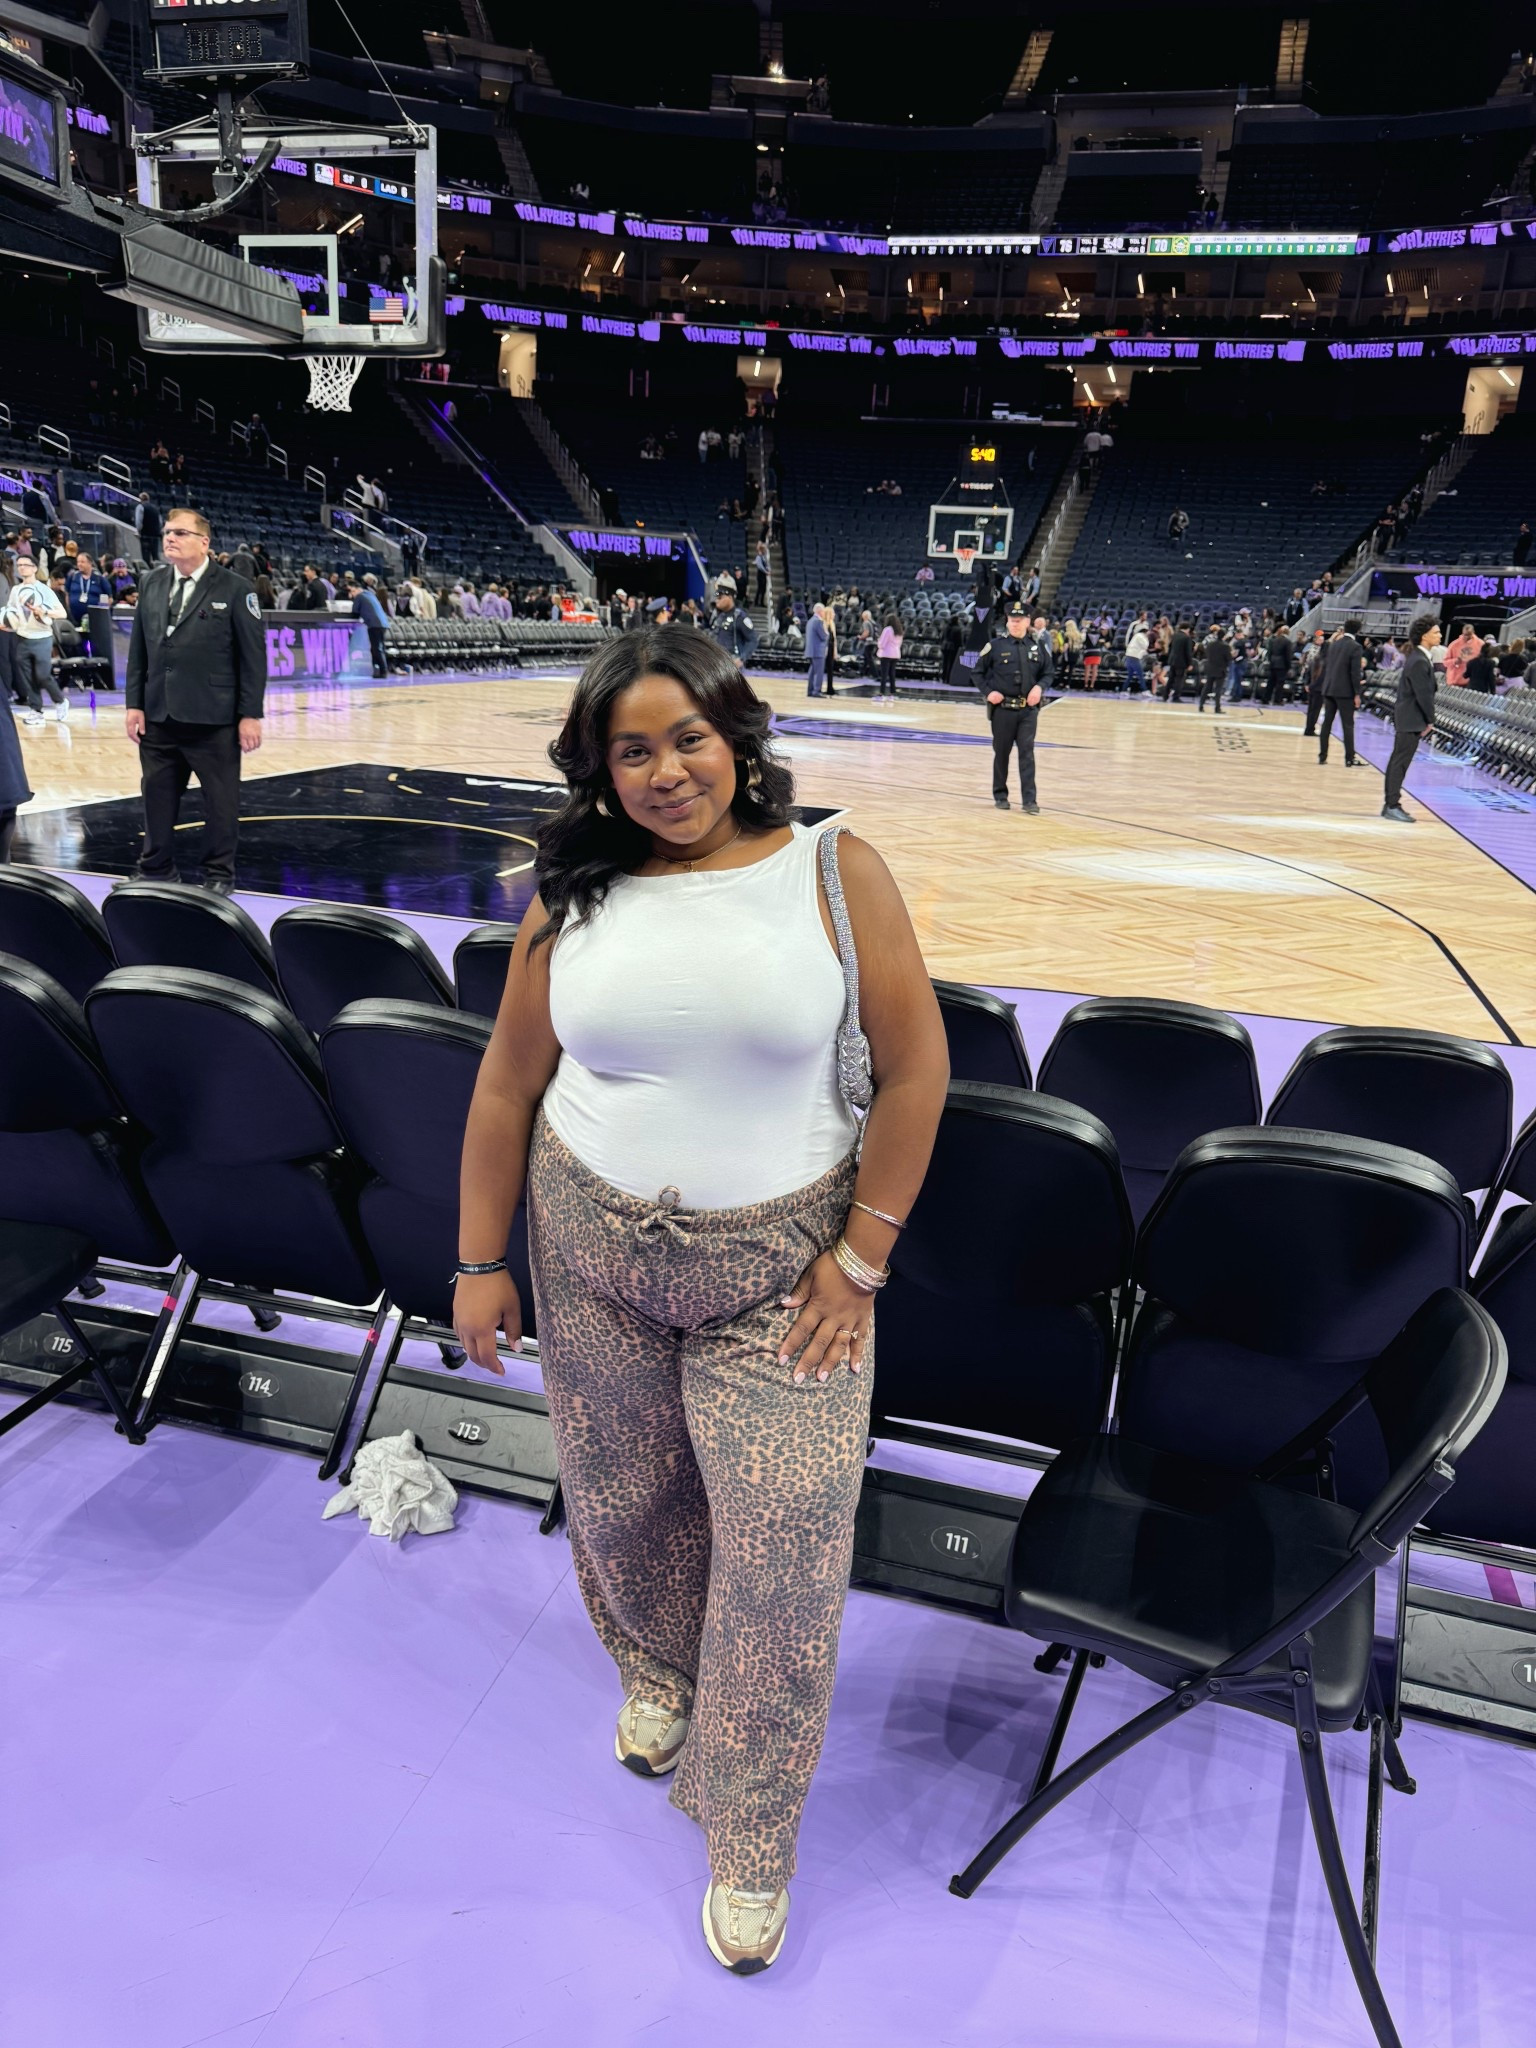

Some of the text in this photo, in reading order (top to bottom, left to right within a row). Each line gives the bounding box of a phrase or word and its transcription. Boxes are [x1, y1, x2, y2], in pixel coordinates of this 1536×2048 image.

[380, 182, 398, 195] LAD
[466, 197, 491, 215] WIN
[514, 203, 576, 227] VALKYRIES
[624, 220, 709, 243] VALKYRIES WIN
[731, 228, 817, 250] VALKYRIES WIN
[1397, 229, 1466, 249] VALKYRIES
[1154, 239, 1168, 252] 70
[481, 303, 541, 326] VALKYRIES
[544, 312, 567, 329] WIN
[682, 325, 741, 345] VALKYRIES
[744, 330, 767, 347] WIN
[788, 332, 872, 354] VALKYRIES WIN
[1450, 335, 1521, 356] VALKYRIES
[893, 337, 977, 356] VALKYRIES WIN
[1109, 340, 1199, 358] VALKYRIES WIN
[1328, 341, 1423, 360] VALKYRIES WIN
[971, 448, 995, 461] 5:40
[568, 530, 671, 556] VALKYRIES WIN
[1414, 573, 1536, 598] VALKYRIES WIN
[301, 629, 350, 674] WIN
[51, 1336, 74, 1353] 115
[248, 1376, 271, 1394] 114
[457, 1421, 481, 1440] 113
[946, 1532, 969, 1554] 111
